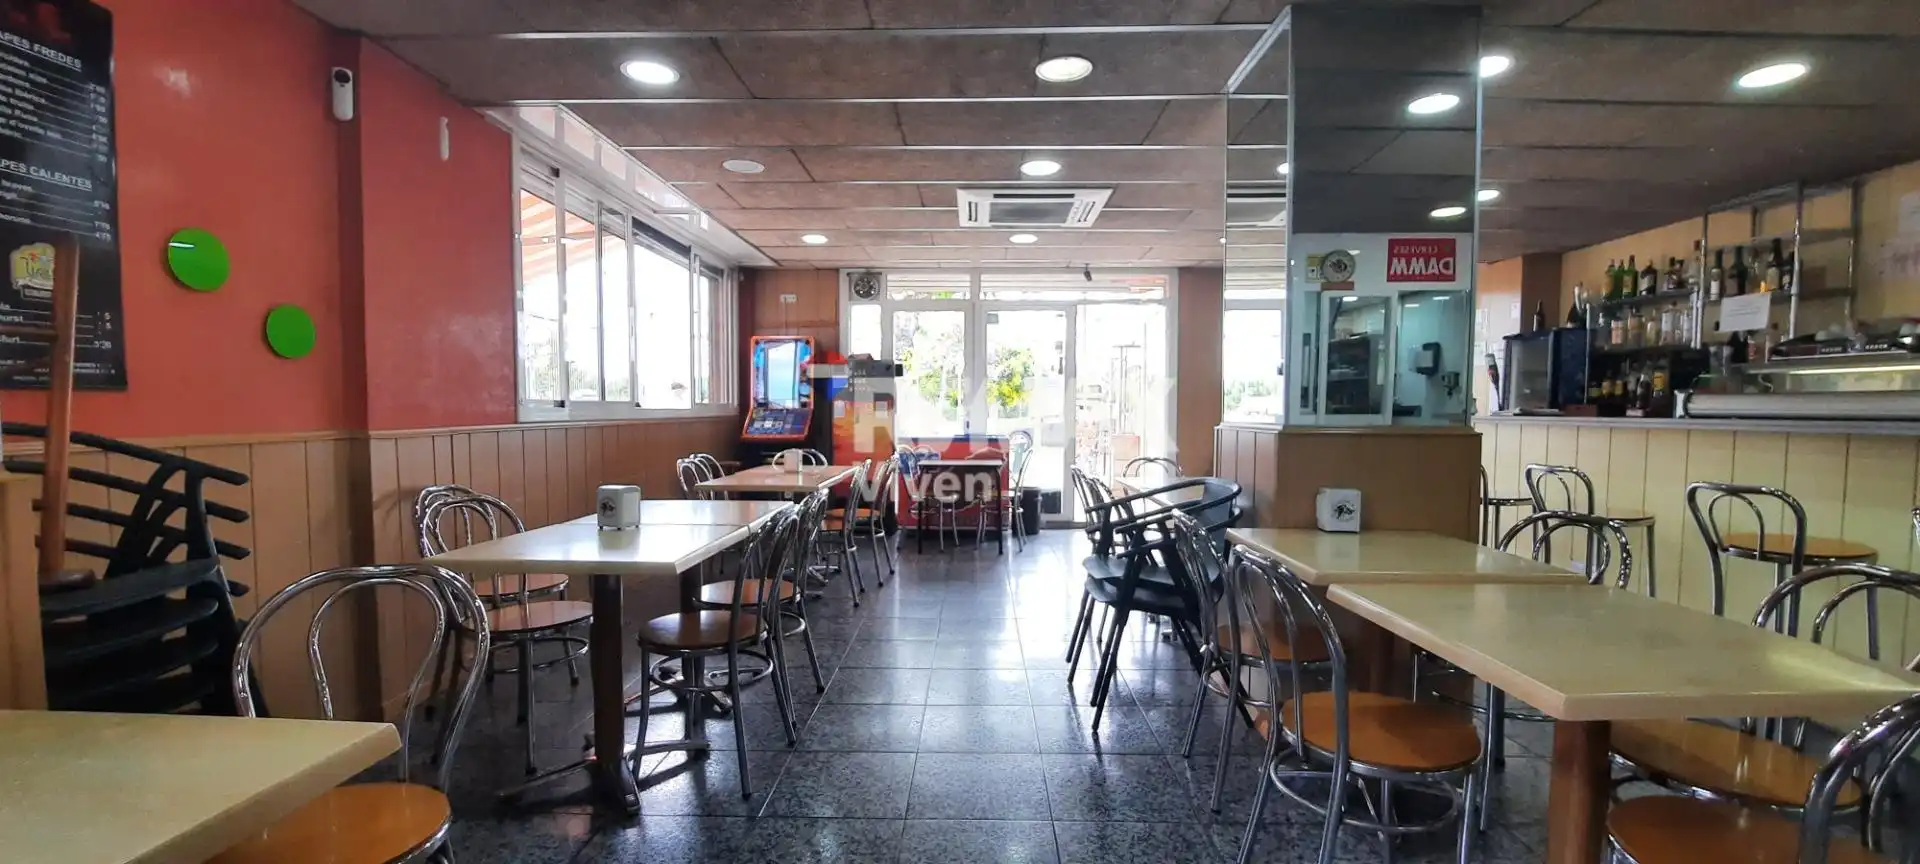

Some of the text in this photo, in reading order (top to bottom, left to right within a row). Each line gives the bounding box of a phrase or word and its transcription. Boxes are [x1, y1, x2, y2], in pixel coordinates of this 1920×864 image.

[33, 42, 82, 69] FREDES
[0, 158, 27, 173] PES
[30, 166, 92, 190] CALENTES
